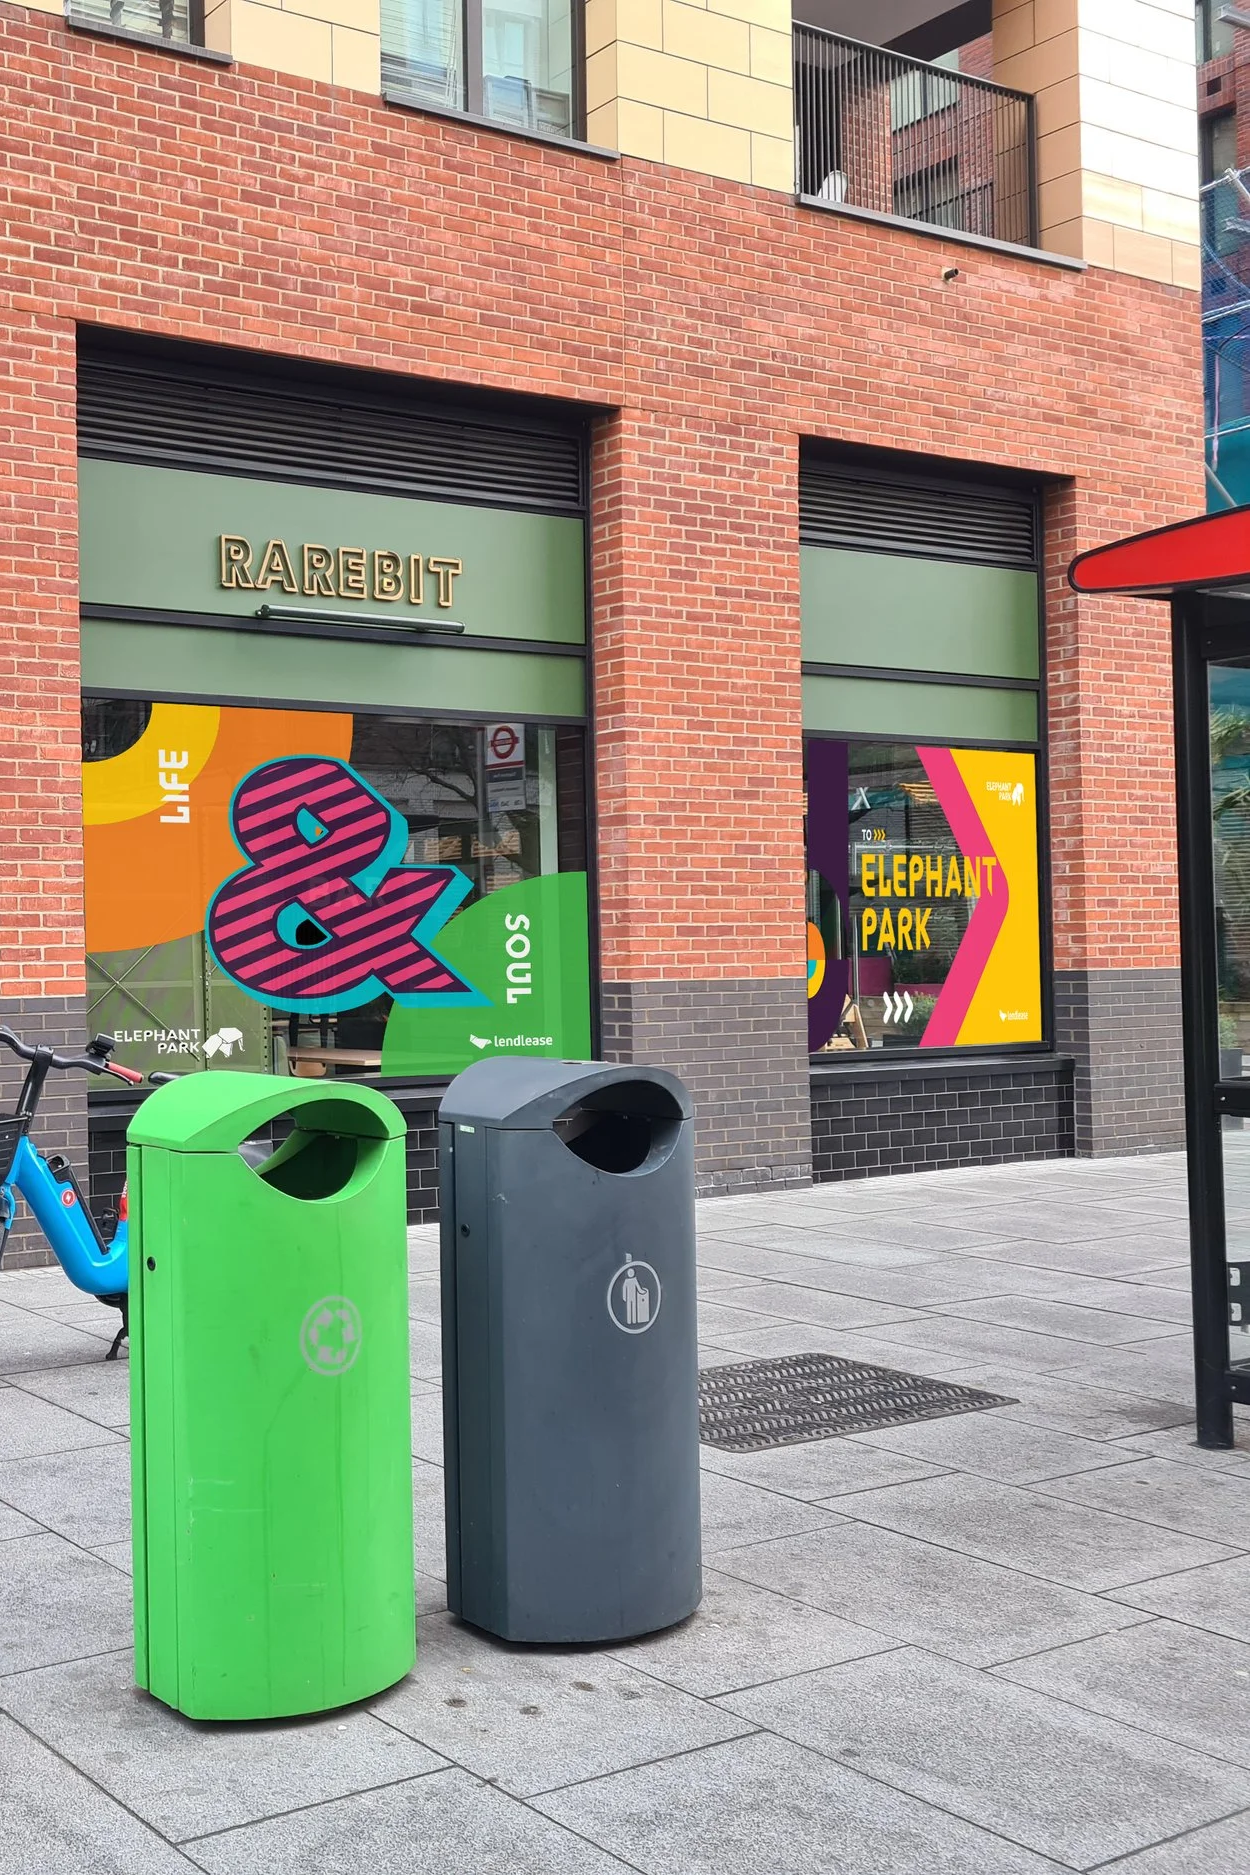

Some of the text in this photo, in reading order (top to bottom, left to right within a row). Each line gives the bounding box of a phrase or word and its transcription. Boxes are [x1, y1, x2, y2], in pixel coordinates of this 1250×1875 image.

[219, 534, 462, 607] RAREBIT
[158, 749, 190, 823] LIFE
[985, 781, 1012, 791] ELEPHANT
[998, 791, 1012, 801] PARK
[861, 829, 872, 841] TO
[205, 754, 495, 1014] &
[861, 853, 997, 897] ELEPHANT
[862, 907, 933, 951] PARK
[505, 914, 531, 1003] SOUL
[113, 1028, 201, 1042] ELEPHANT
[157, 1042, 201, 1054] PARK
[494, 1034, 553, 1047] lendlease
